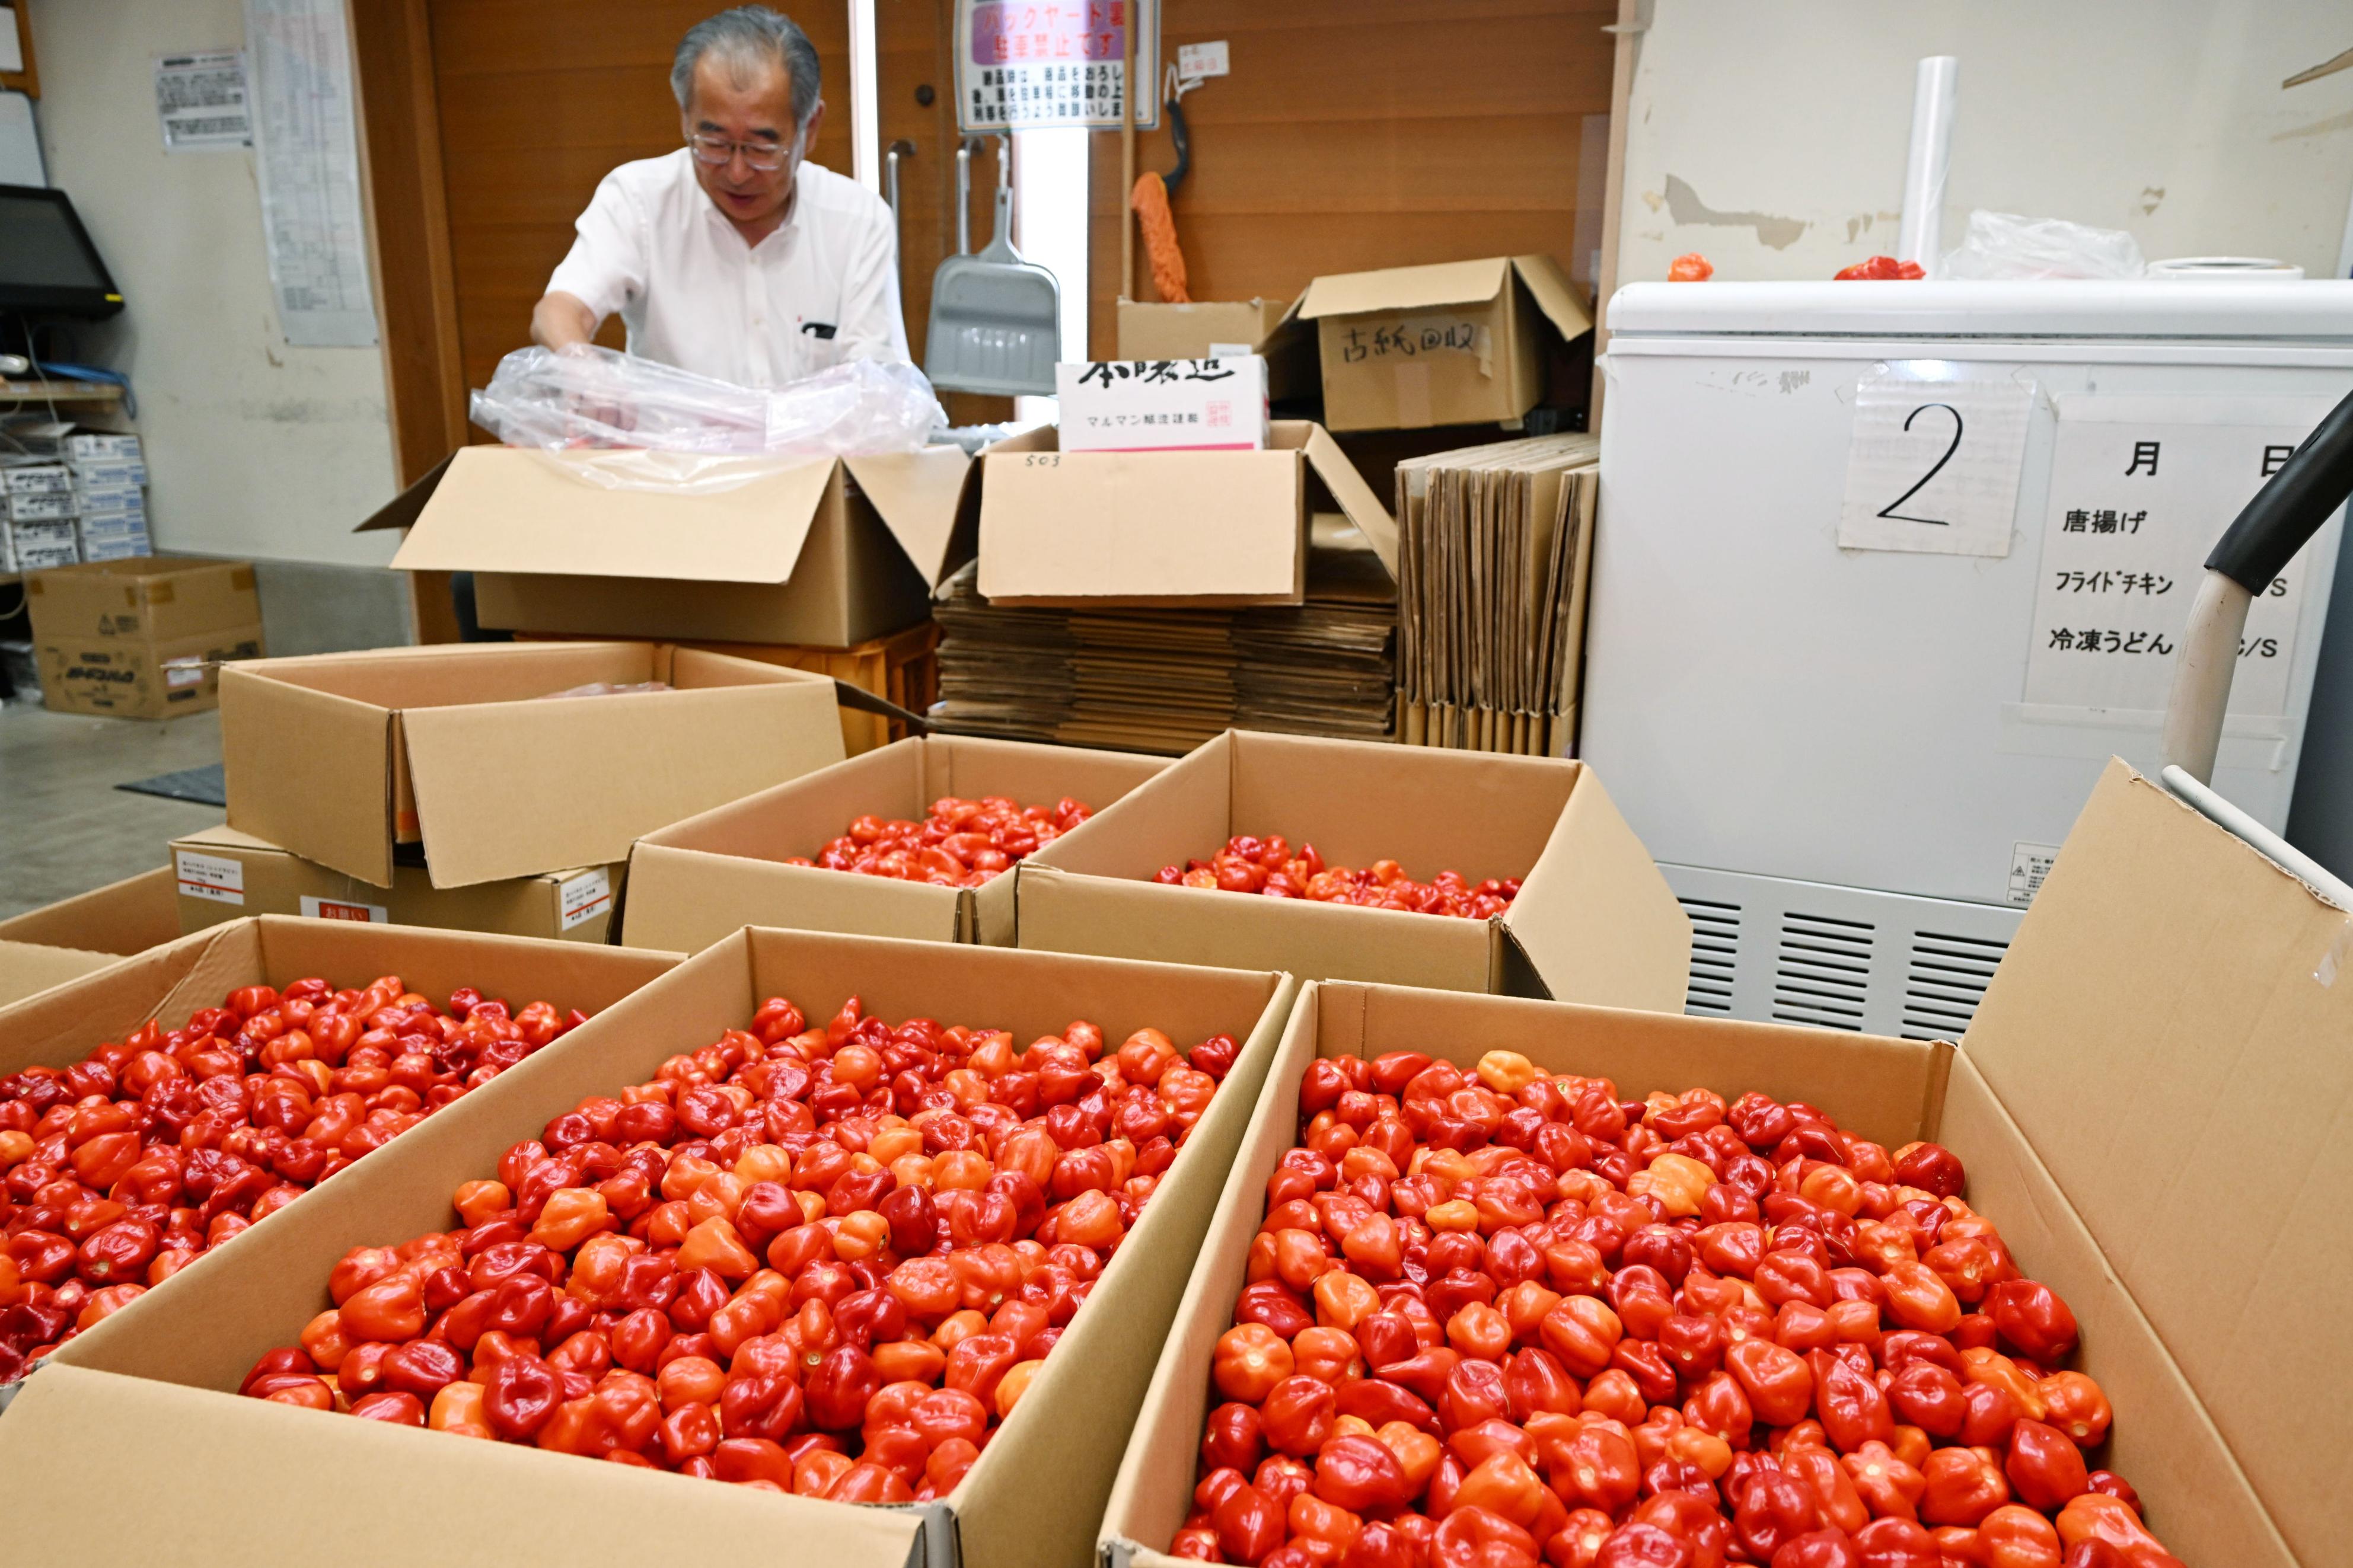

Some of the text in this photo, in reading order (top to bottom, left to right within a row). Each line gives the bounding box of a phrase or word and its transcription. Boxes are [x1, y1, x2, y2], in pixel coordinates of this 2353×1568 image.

[993, 33, 1115, 60] 駐車禁止です
[1341, 323, 1474, 363] 古紙回収
[1025, 454, 1061, 467] 503
[1876, 403, 1963, 526] 2
[2125, 442, 2161, 476] 月
[2062, 509, 2148, 534] 唐揚げ
[2048, 628, 2174, 654] 冷凍うどん
